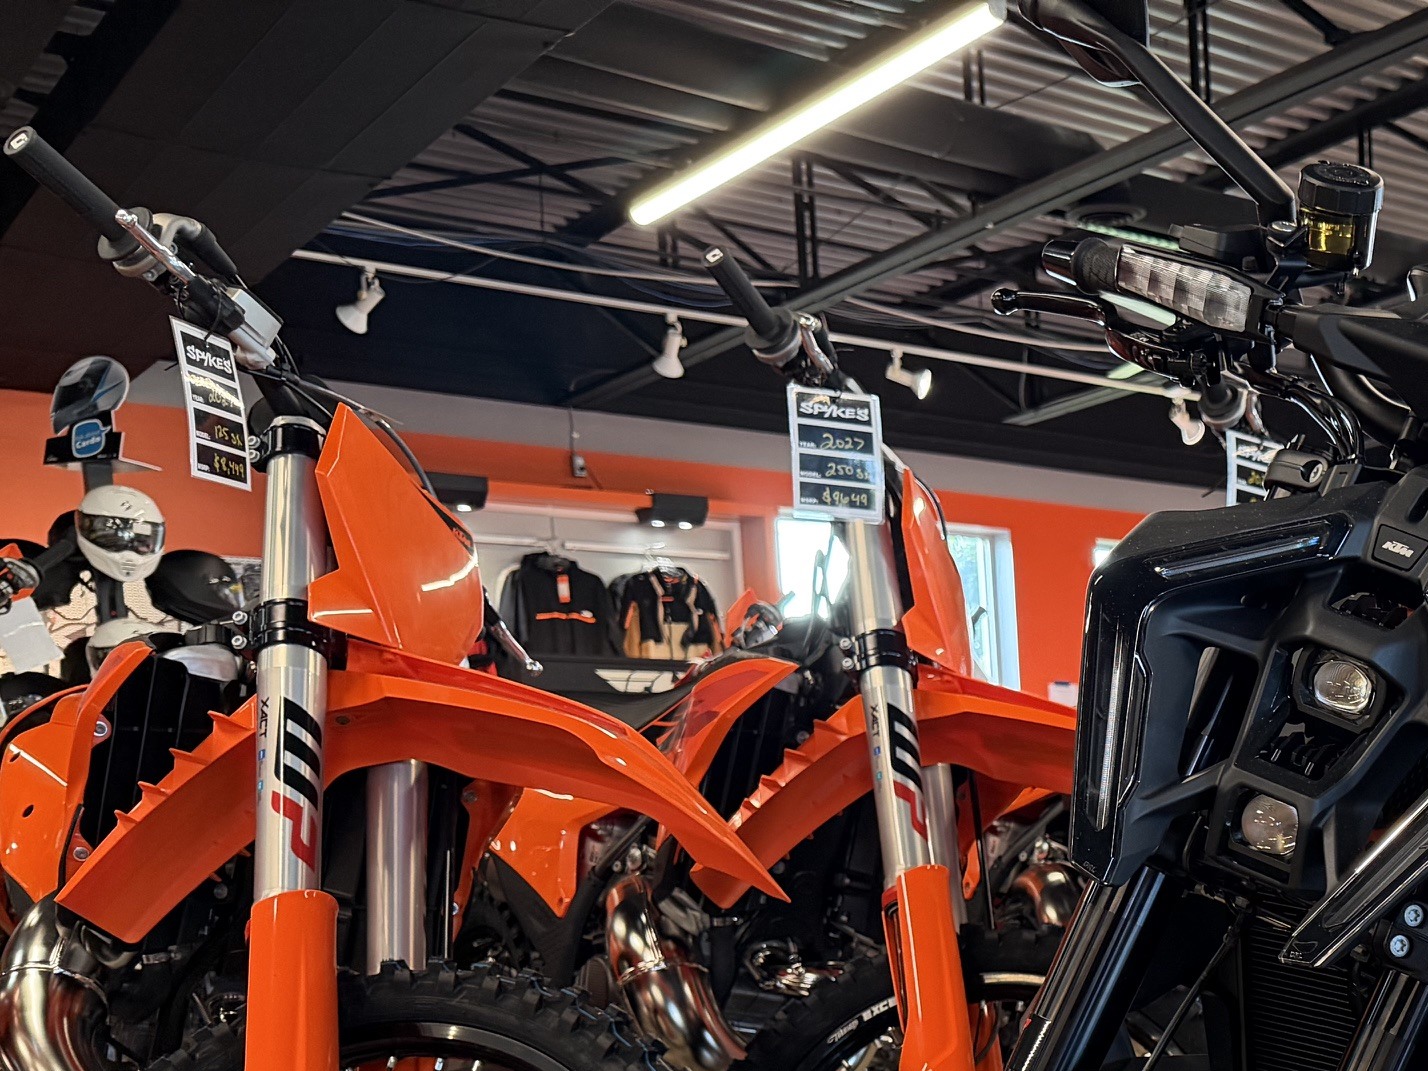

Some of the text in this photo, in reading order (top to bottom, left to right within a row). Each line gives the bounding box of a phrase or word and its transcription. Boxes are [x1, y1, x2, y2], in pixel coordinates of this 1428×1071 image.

[186, 344, 232, 374] SPYKE'S
[799, 401, 870, 422] SPYKE'S
[214, 425, 229, 440] 125
[825, 462, 854, 478] 250
[1382, 541, 1414, 558] KTM
[258, 696, 270, 738] XACT
